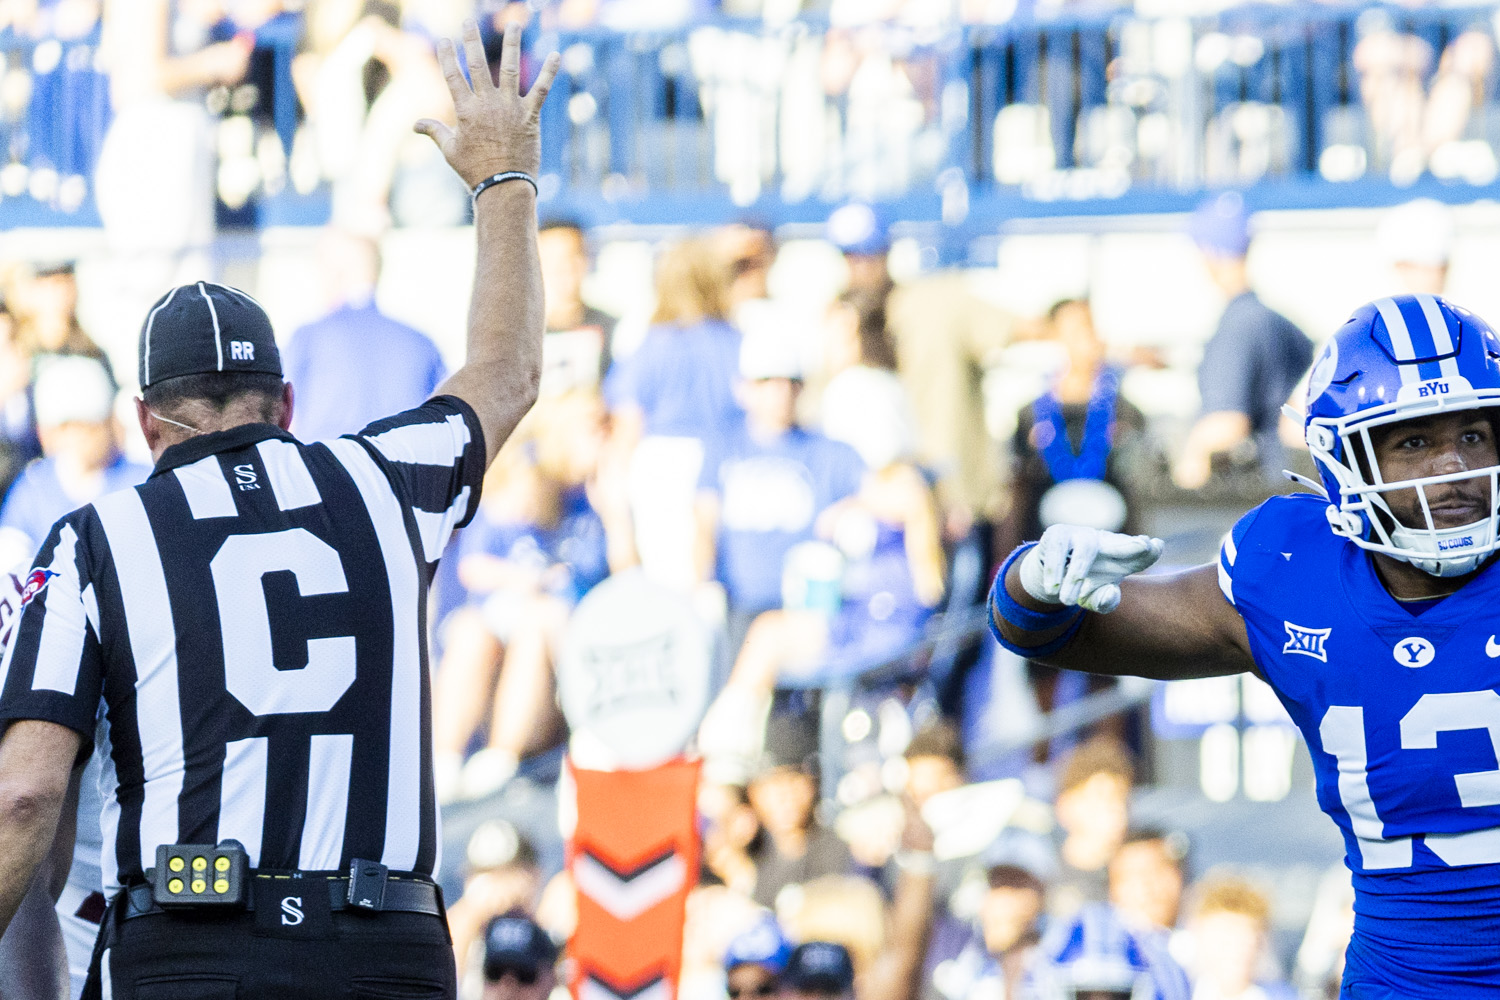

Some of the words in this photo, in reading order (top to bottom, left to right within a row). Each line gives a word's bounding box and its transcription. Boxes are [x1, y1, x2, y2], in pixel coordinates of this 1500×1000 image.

[230, 341, 255, 360] RR
[1418, 381, 1449, 397] BYU
[1449, 536, 1473, 549] COUGS
[209, 528, 357, 716] C
[1402, 643, 1426, 662] Y
[281, 897, 304, 925] S
